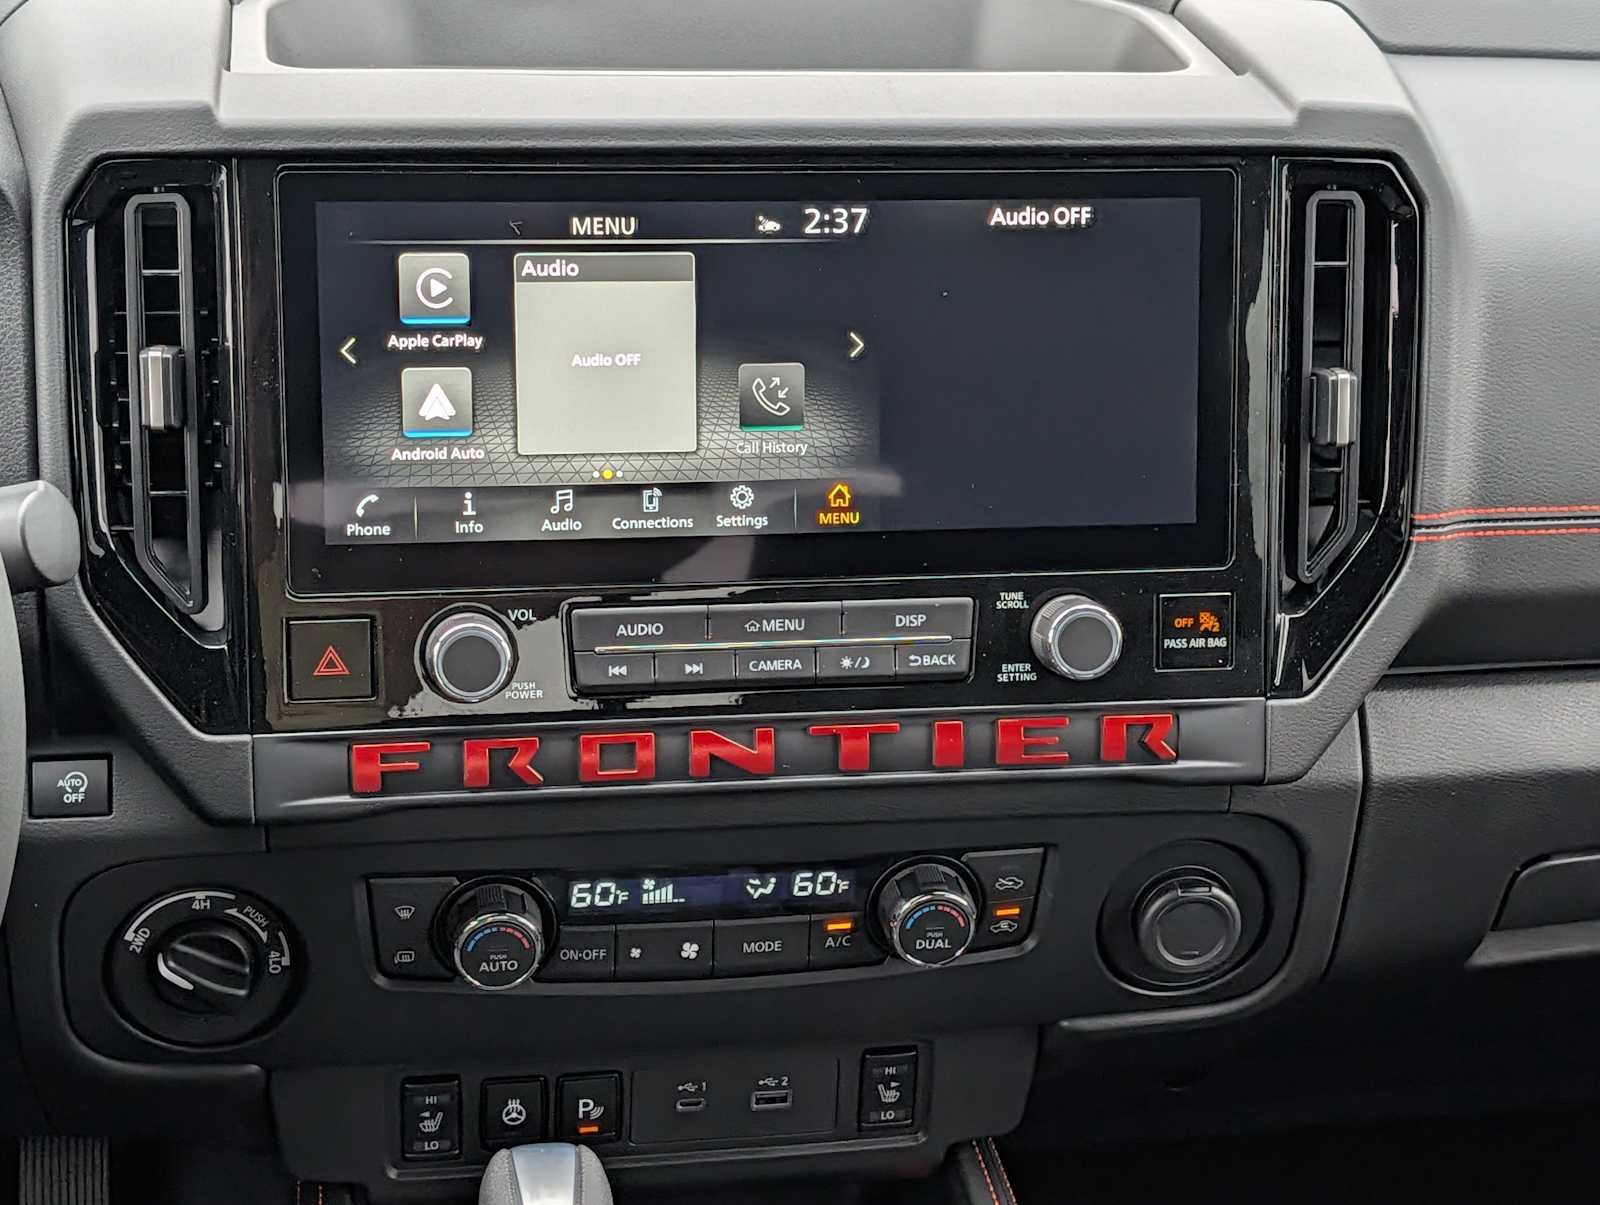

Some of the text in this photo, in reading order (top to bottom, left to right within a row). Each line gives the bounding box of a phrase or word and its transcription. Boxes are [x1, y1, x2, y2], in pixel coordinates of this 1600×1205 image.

[804, 207, 869, 234] 2:37
[989, 206, 1092, 226] Audio OFF
[571, 217, 638, 237] MENU
[521, 259, 580, 277] Audio
[388, 333, 483, 350] Apple CarPlay
[571, 353, 641, 367] Audio OFF
[391, 447, 485, 460] Android Auto
[736, 441, 808, 455] Call History
[541, 517, 582, 532] Audio
[612, 514, 693, 530] Connections
[716, 513, 769, 529] Settings
[818, 511, 860, 526] MENU
[346, 523, 391, 537] Phone
[455, 520, 484, 534] Info
[1000, 592, 1024, 600] TUNE
[996, 600, 1030, 609] SCROLL
[507, 609, 537, 621] VOL
[895, 614, 926, 628] DISP
[762, 618, 805, 632] MENU
[1174, 617, 1195, 628] OFF
[616, 623, 664, 636] AUDIO
[1163, 637, 1228, 649] PASS AIR BAG
[749, 659, 802, 672] CAMERA
[923, 654, 956, 666] BACK
[1002, 664, 1031, 673] ENTER
[996, 672, 1037, 682] SETTING
[511, 682, 536, 690] PUSH
[505, 689, 544, 699] POWER
[351, 713, 1179, 793] FRONTIER
[57, 779, 82, 787] AUTO
[63, 793, 85, 803] OFF
[191, 899, 211, 911] 4H
[243, 905, 270, 928] PUSH
[129, 927, 151, 954] 2WD
[742, 940, 783, 953] MODE
[824, 935, 852, 948] A/C
[915, 938, 952, 949] DUAL
[268, 950, 282, 974] 4LO
[479, 960, 518, 972] AUTO
[884, 1066, 896, 1075] HI
[781, 1077, 789, 1086] 2
[425, 1095, 437, 1105] HI
[880, 1110, 895, 1120] LO
[424, 1140, 439, 1150] LO
